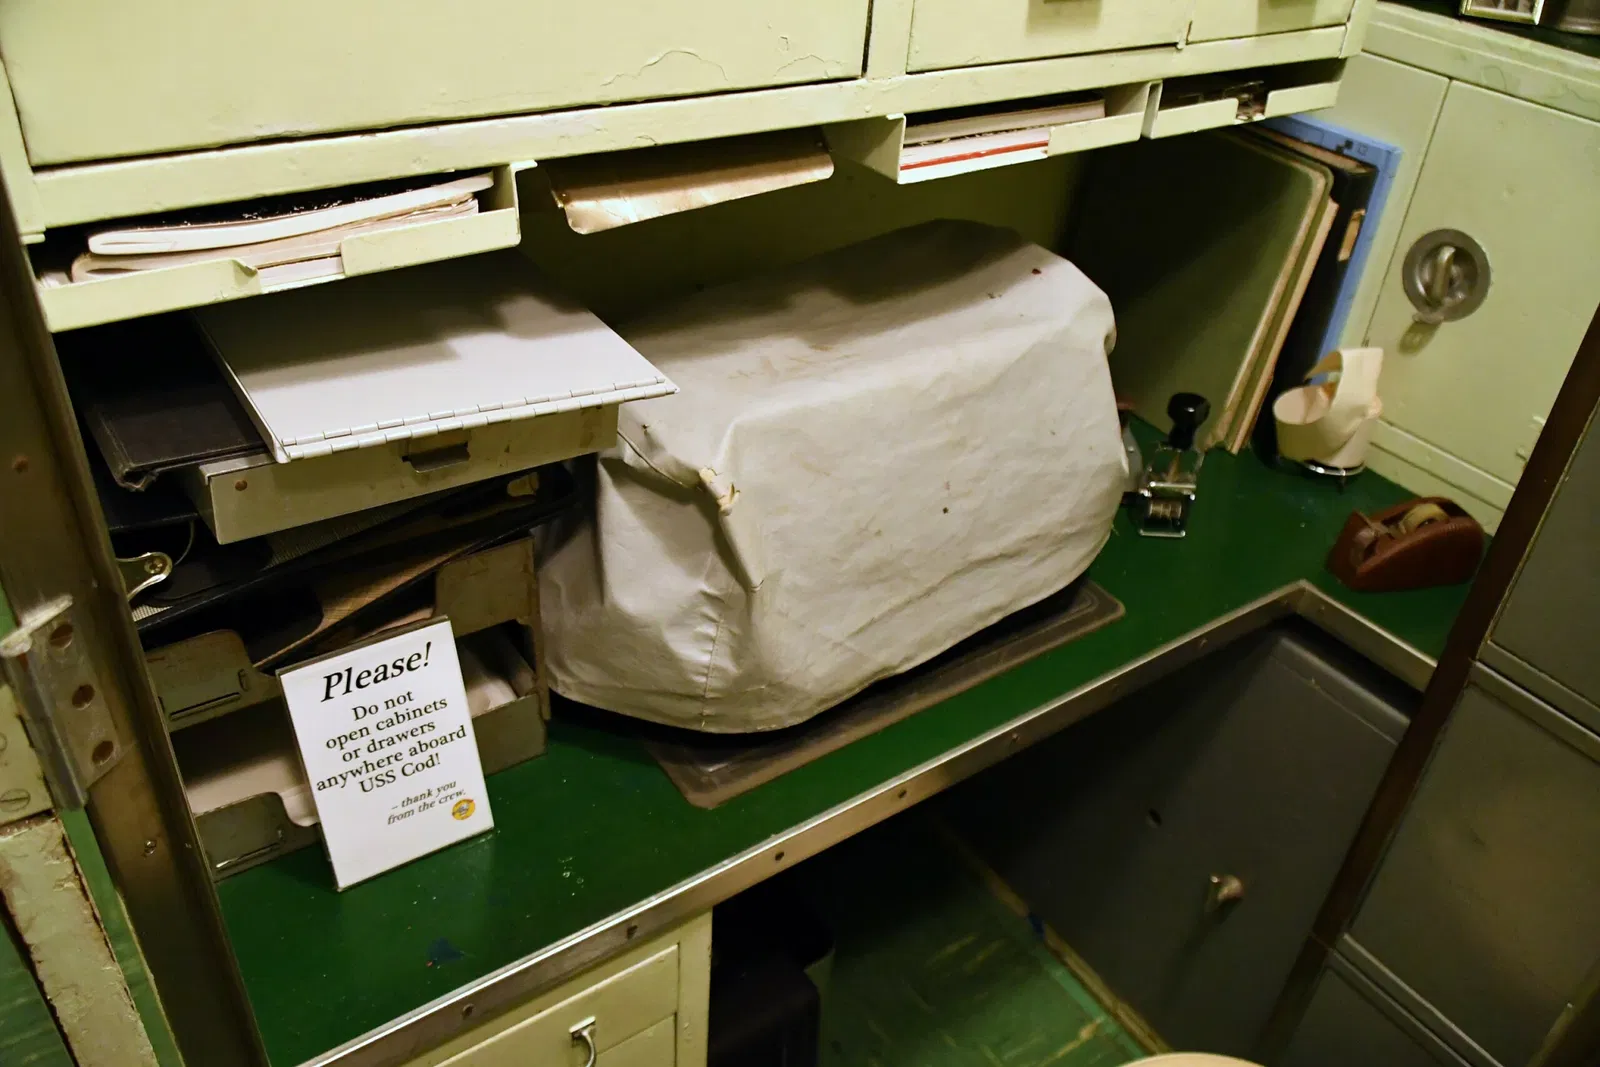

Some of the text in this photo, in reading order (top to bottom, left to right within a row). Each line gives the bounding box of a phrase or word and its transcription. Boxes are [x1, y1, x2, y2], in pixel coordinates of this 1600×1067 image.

[320, 641, 431, 702] Please!
[325, 698, 448, 750] open cabinets
[352, 690, 414, 721] Do not
[316, 725, 467, 791] anywhere aboard
[342, 720, 436, 763] or drawers
[359, 753, 441, 793] USS Cod!
[387, 809, 415, 825] from
[417, 800, 436, 813] the
[438, 788, 467, 805] crew.
[401, 788, 433, 808] thank
[436, 780, 457, 798] you
